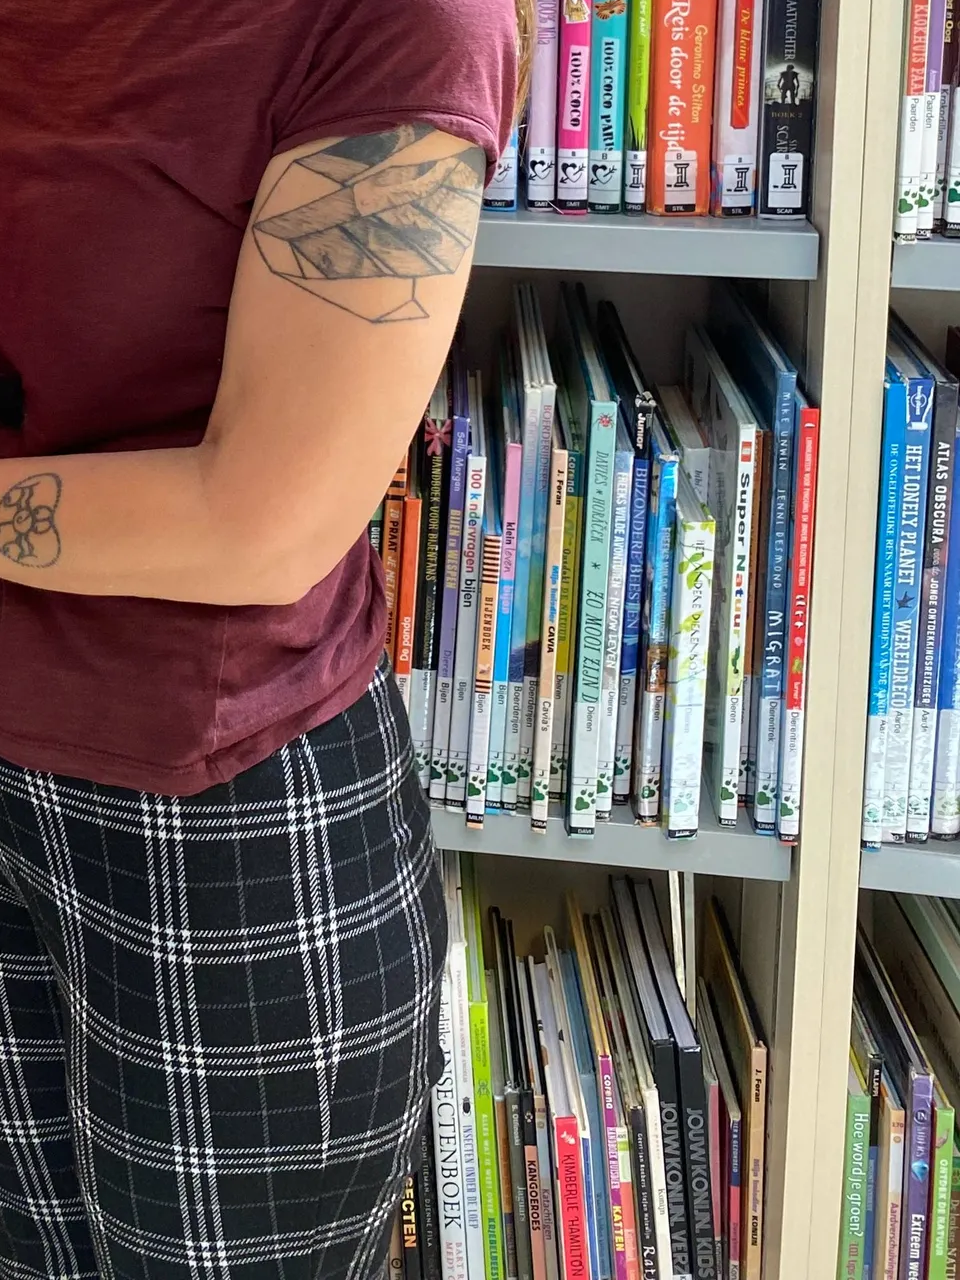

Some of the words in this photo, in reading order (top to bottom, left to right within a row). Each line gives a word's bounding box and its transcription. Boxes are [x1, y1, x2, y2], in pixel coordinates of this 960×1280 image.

[740, 7, 751, 26] De
[602, 41, 615, 73] 100%
[693, 24, 709, 80] Geronimo
[739, 28, 750, 62] kleine
[570, 51, 582, 86] 100%
[670, 46, 689, 90] door
[735, 63, 747, 108] prinses
[570, 90, 581, 127] COCO
[602, 75, 614, 109] COCO
[668, 95, 687, 117] de
[691, 84, 706, 124] Stilton
[909, 97, 919, 133] Paarden
[926, 94, 936, 129] Paarden
[780, 391, 791, 423] MIKE
[637, 412, 647, 450] Junior
[596, 450, 610, 487] DAVIES
[778, 430, 789, 471] UNWIN
[905, 445, 922, 470] HET
[935, 441, 950, 480] ATLAS
[429, 456, 443, 502] HANDBOEK
[452, 457, 465, 492] Morgan
[470, 468, 483, 490] 100
[555, 480, 564, 506] Foran
[628, 467, 649, 562] BIJZONDERE
[737, 472, 750, 542] Super
[776, 489, 786, 525] JENNI
[902, 474, 920, 529] LONELY
[931, 485, 947, 545] OBSCURA
[505, 521, 516, 545] klein
[773, 531, 785, 589] DESMOND
[898, 531, 917, 585] PLANET
[463, 578, 477, 608] bijen
[585, 589, 604, 609] ZO
[733, 554, 746, 639] Natuur
[400, 616, 411, 645] panda
[482, 596, 494, 651] BIJENBOEK
[608, 597, 620, 631] NIEUW
[584, 613, 603, 653] MOOI
[606, 632, 618, 669] LEVEN
[582, 655, 601, 689] ZIJN
[730, 697, 739, 724] Dieren
[753, 1078, 762, 1103] Foran
[463, 1124, 474, 1164] INSECTEN
[853, 1112, 869, 1141] Hoe
[851, 1142, 867, 1175] word
[465, 1166, 477, 1194] ONDER
[527, 1160, 541, 1231] KANGOEROES
[563, 1154, 579, 1212] KIMBERLIE
[541, 1188, 553, 1241] Katachtigen
[613, 1205, 625, 1252] KATTEN
[847, 1194, 864, 1238] groen?
[568, 1216, 584, 1277] HAMILTON
[909, 1213, 925, 1259] Extreem
